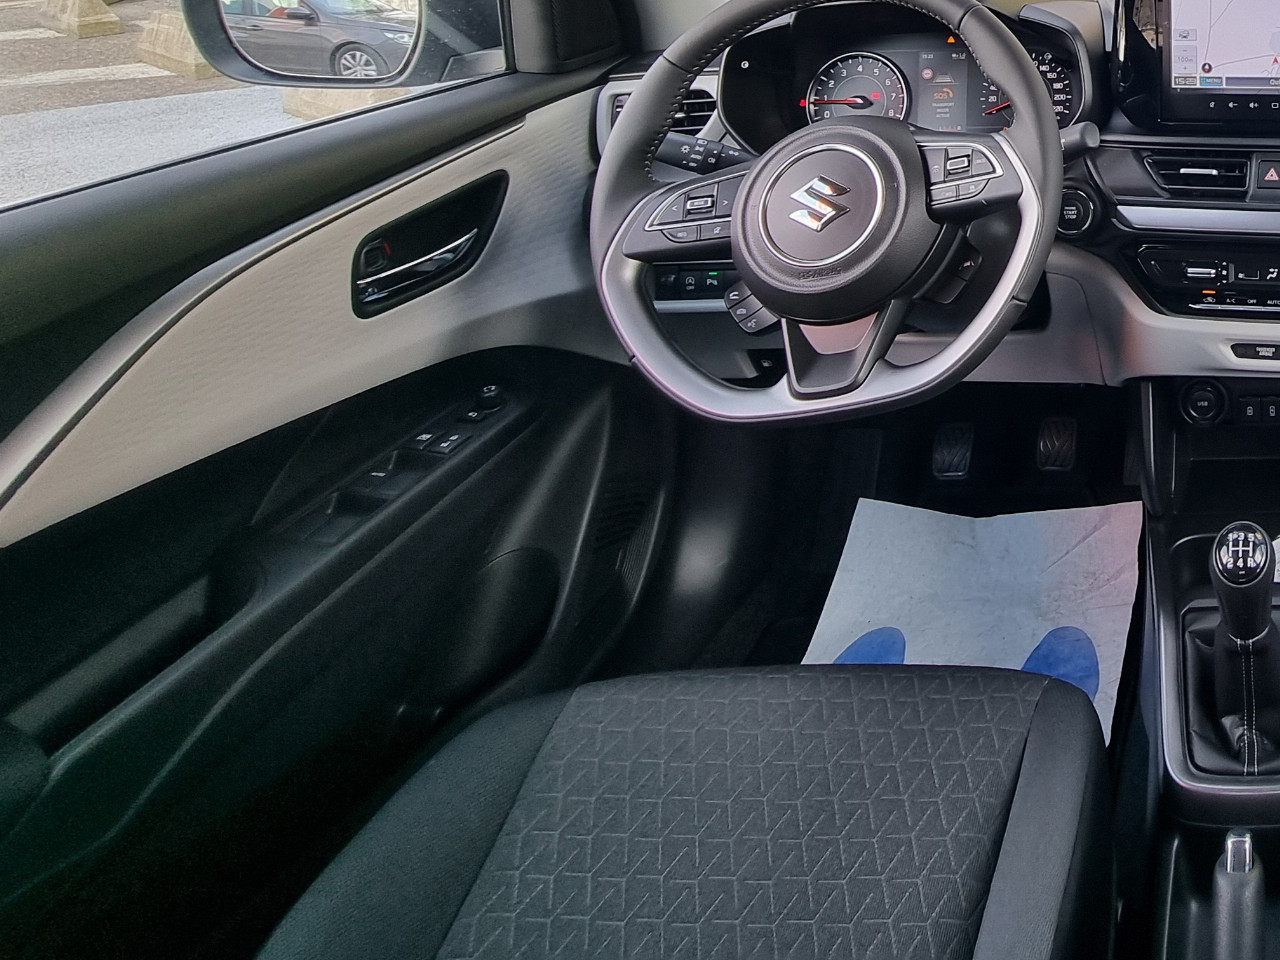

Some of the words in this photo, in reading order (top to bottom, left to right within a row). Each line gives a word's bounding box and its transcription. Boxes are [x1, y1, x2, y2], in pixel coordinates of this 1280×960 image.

[856, 64, 863, 72] 4
[873, 68, 880, 76] 5
[841, 69, 847, 77] 3
[828, 80, 835, 88] 2
[885, 78, 891, 86] 6
[890, 92, 896, 101] 7
[933, 92, 948, 100] SOS
[824, 110, 830, 119] 0
[888, 109, 894, 117] 8
[1237, 532, 1245, 541] 3
[1247, 532, 1255, 542] 5
[1226, 557, 1235, 570] 2
[1236, 557, 1245, 569] 4
[1247, 557, 1257, 568] R
